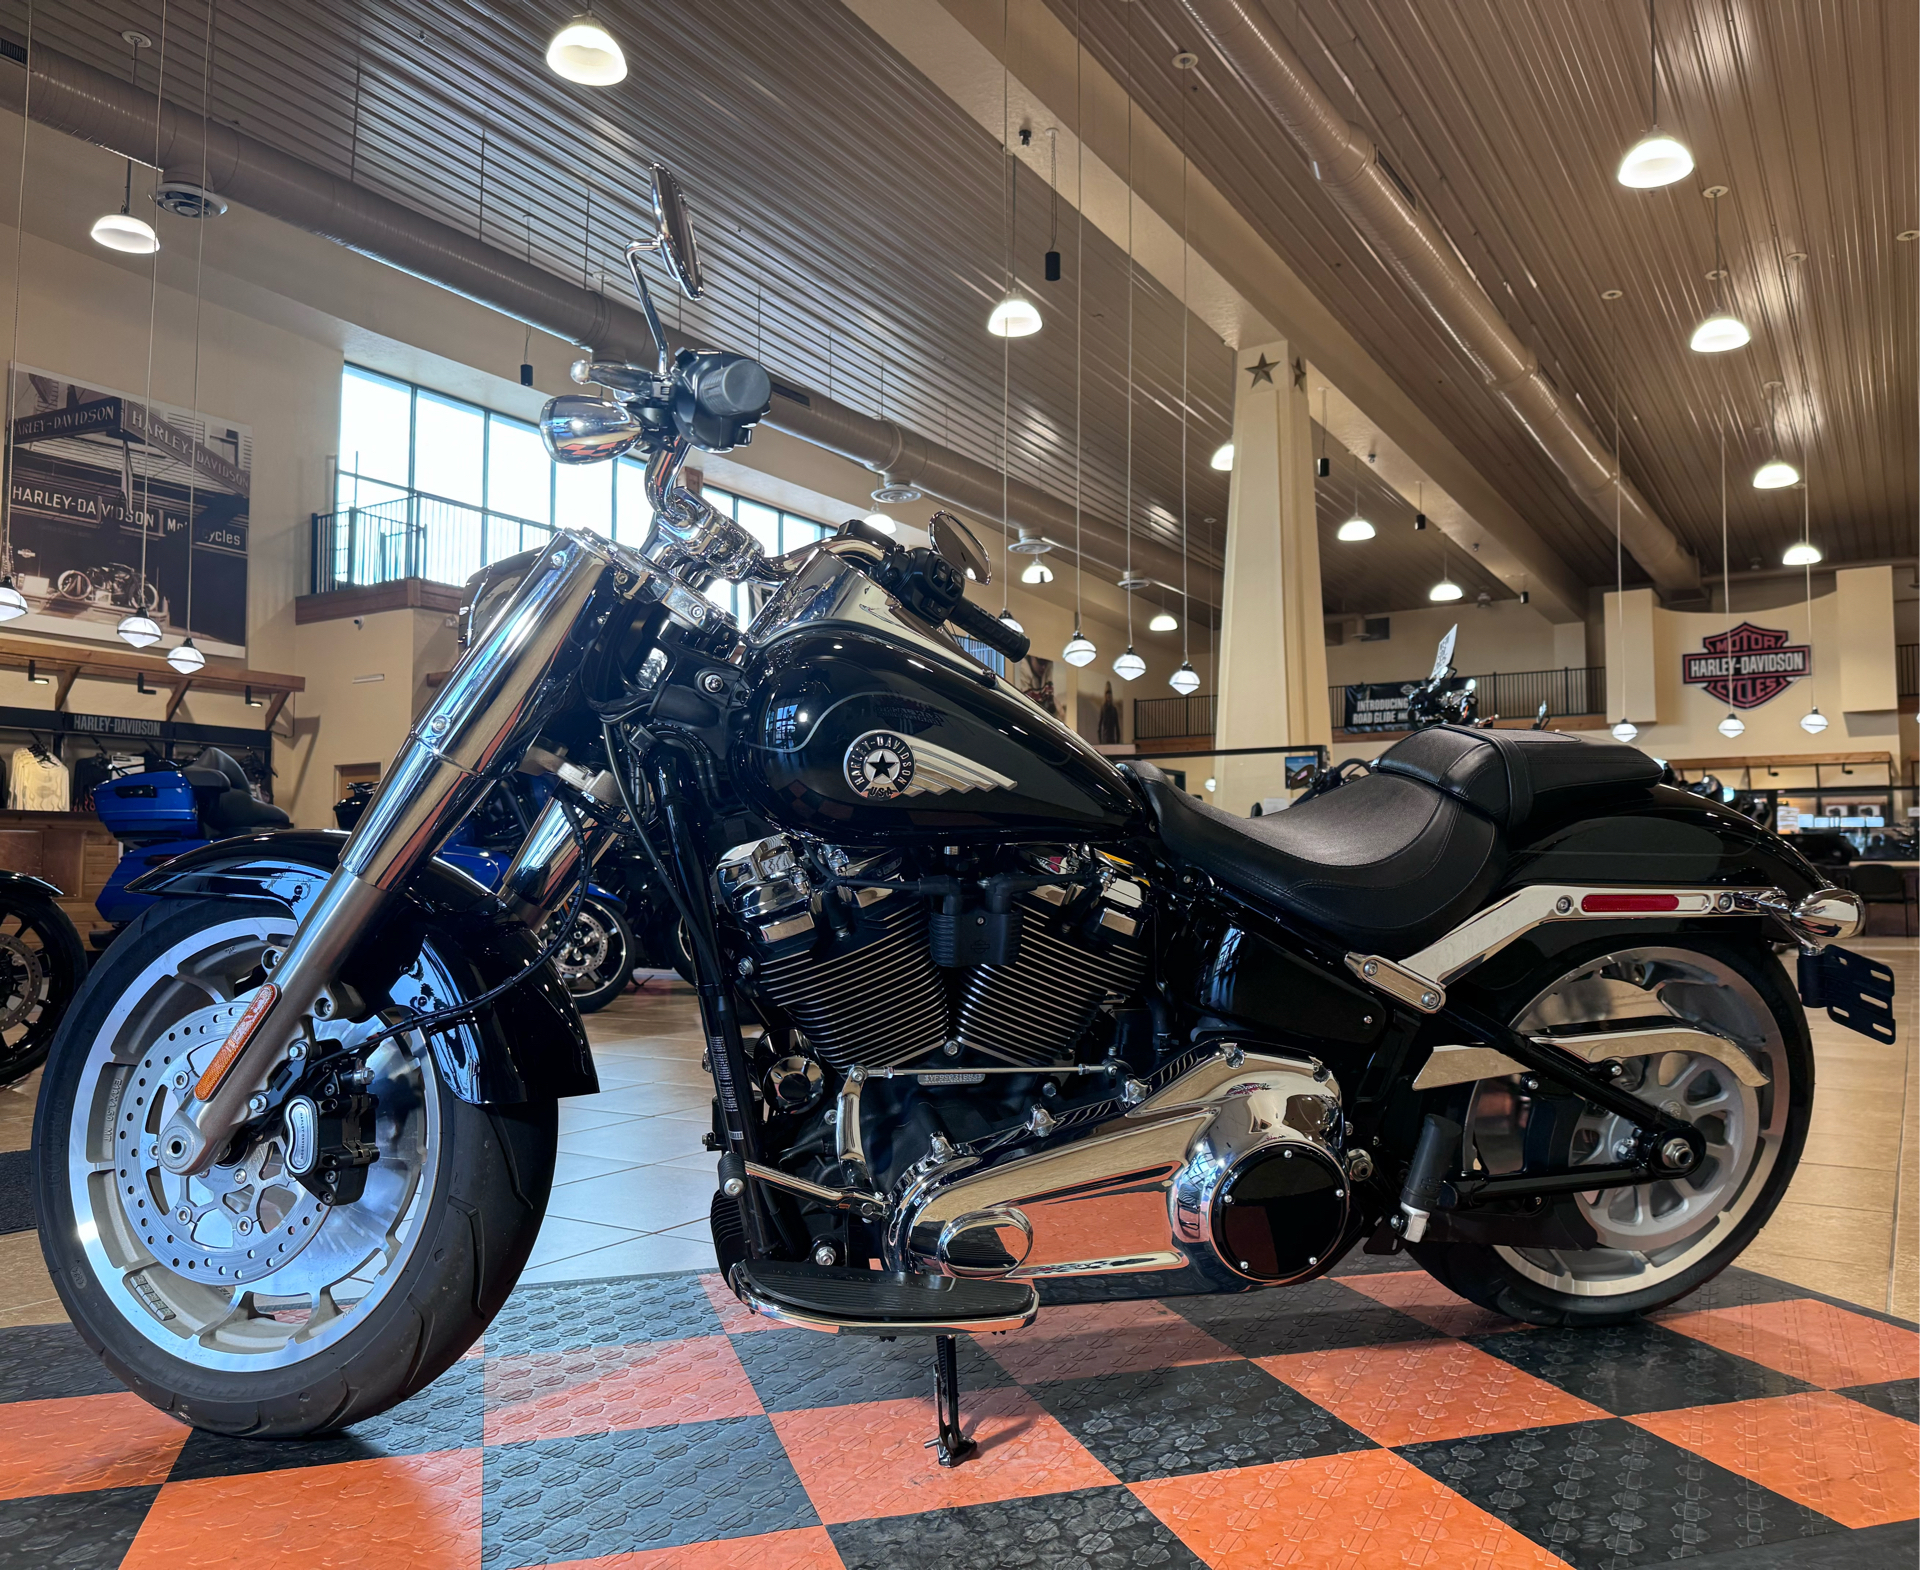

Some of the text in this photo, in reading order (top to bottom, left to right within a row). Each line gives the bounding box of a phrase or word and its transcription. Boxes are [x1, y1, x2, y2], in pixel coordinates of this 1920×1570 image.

[11, 405, 115, 437] ARLEY-DAVIDSON
[131, 409, 250, 490] HARLEY-DAVIDSON
[1716, 630, 1777, 653] MOTOR
[1690, 652, 1804, 678] HARLEY-DAVIDSON
[1716, 678, 1777, 701] CYCLES
[1357, 697, 1408, 711] INTRODUCING
[73, 714, 161, 737] HARLEY-DAVIDSON
[1353, 713, 1373, 724] ROAD
[1374, 711, 1396, 723] GLIDE
[850, 735, 912, 786] HARLEY-DAVIDSON
[869, 786, 895, 799] USA
